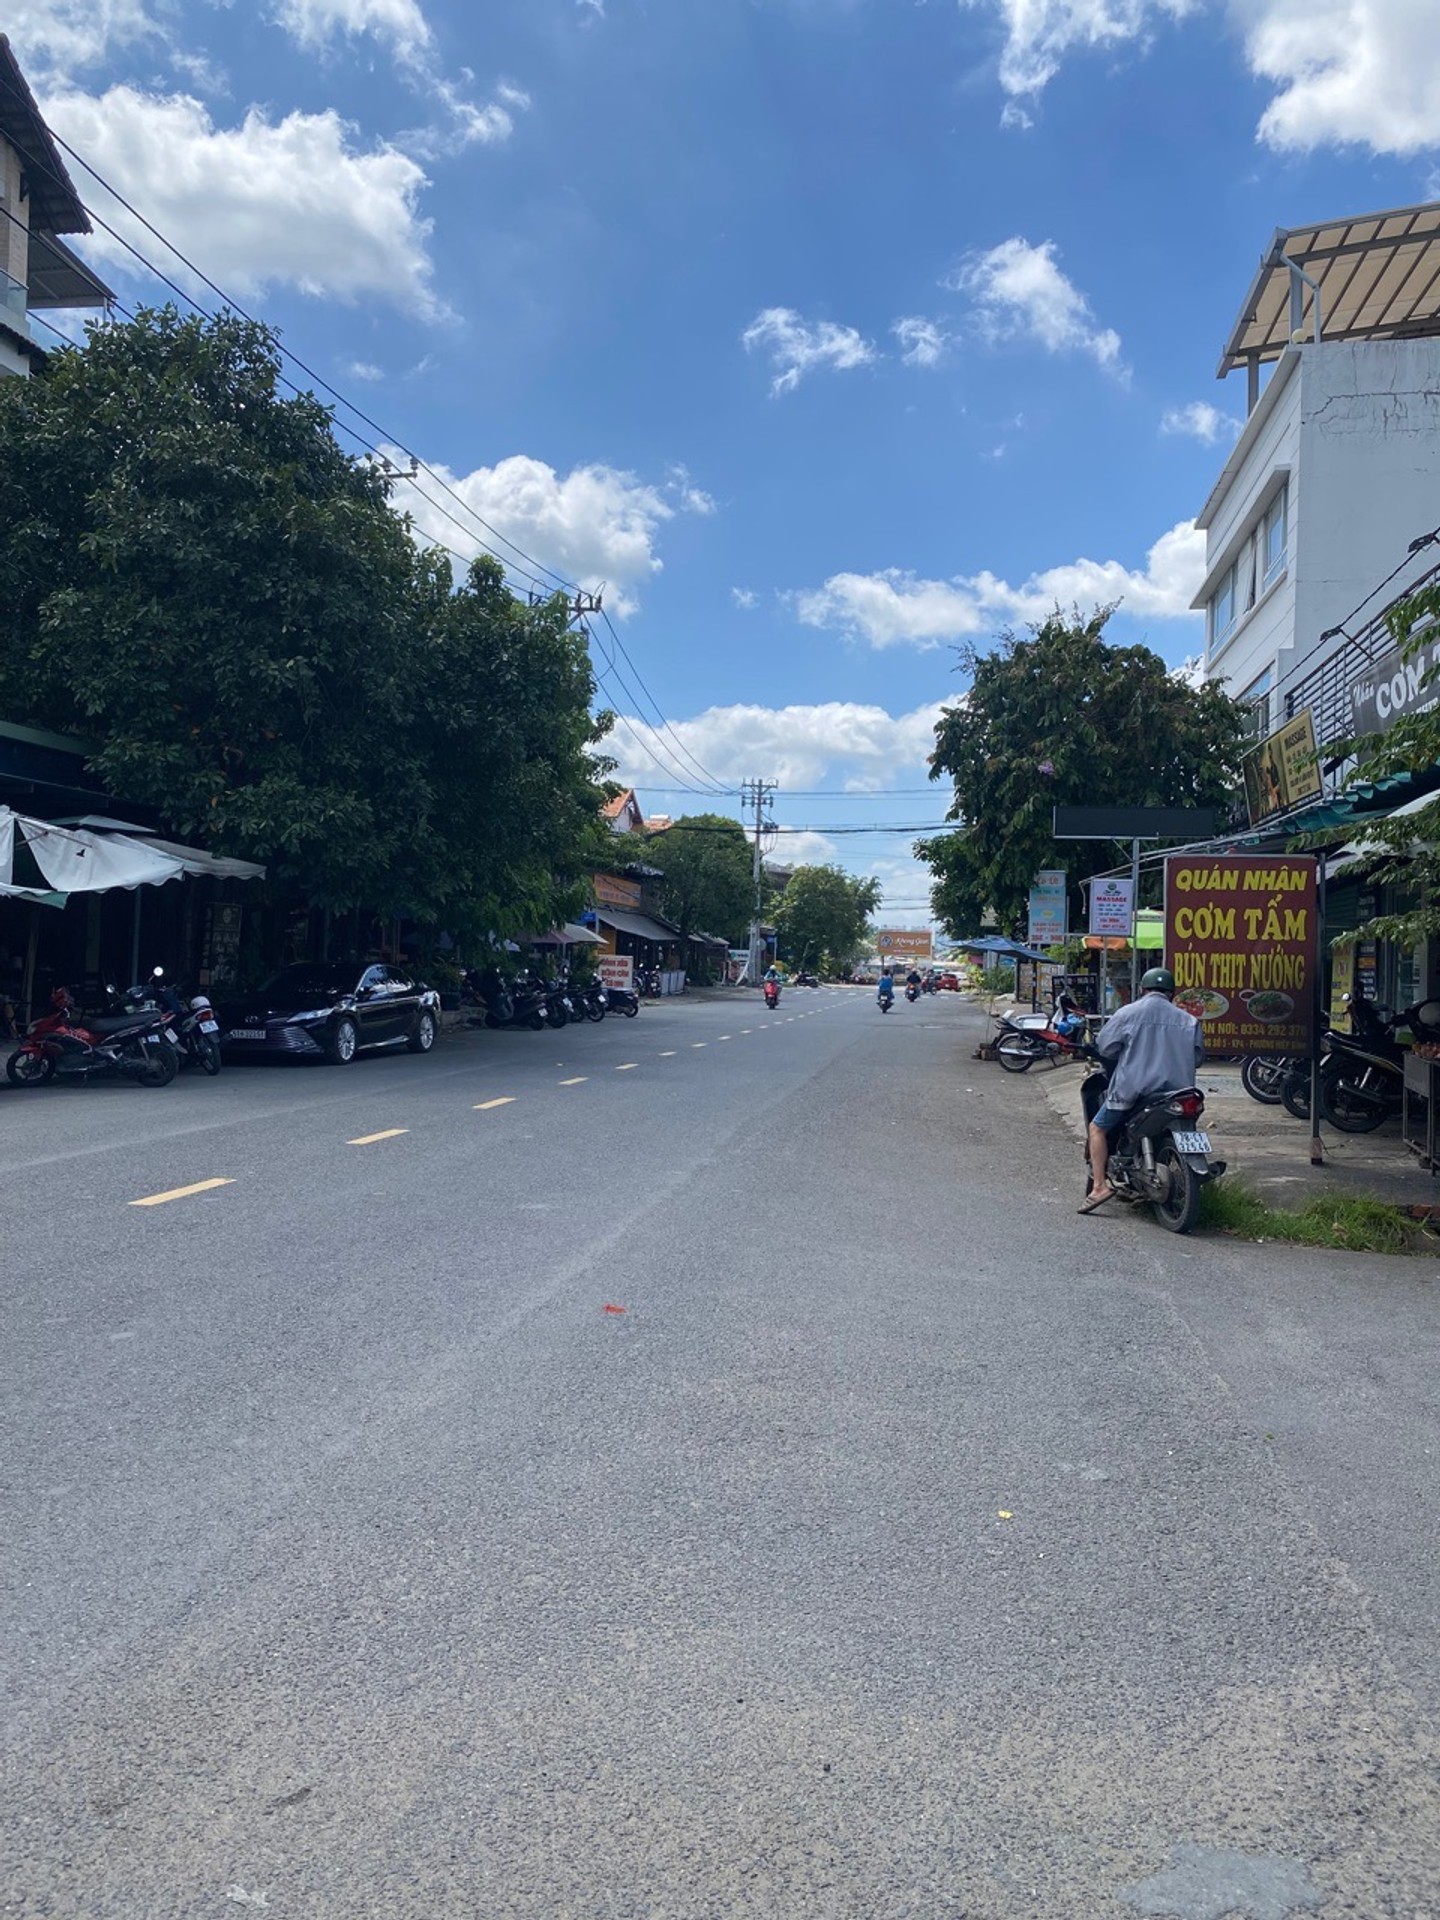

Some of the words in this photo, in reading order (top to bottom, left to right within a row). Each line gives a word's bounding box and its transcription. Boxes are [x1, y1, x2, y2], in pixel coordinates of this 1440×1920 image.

[1175, 863, 1239, 893] QUÁN
[1242, 865, 1308, 891] NHÂN
[1174, 901, 1236, 940] CƠM
[1243, 893, 1307, 940] TẤM
[1174, 942, 1207, 988] BÚN
[1210, 953, 1246, 998] THỊT
[1250, 944, 1306, 990] NƯỚNG
[1202, 1020, 1215, 1036] ẬN
